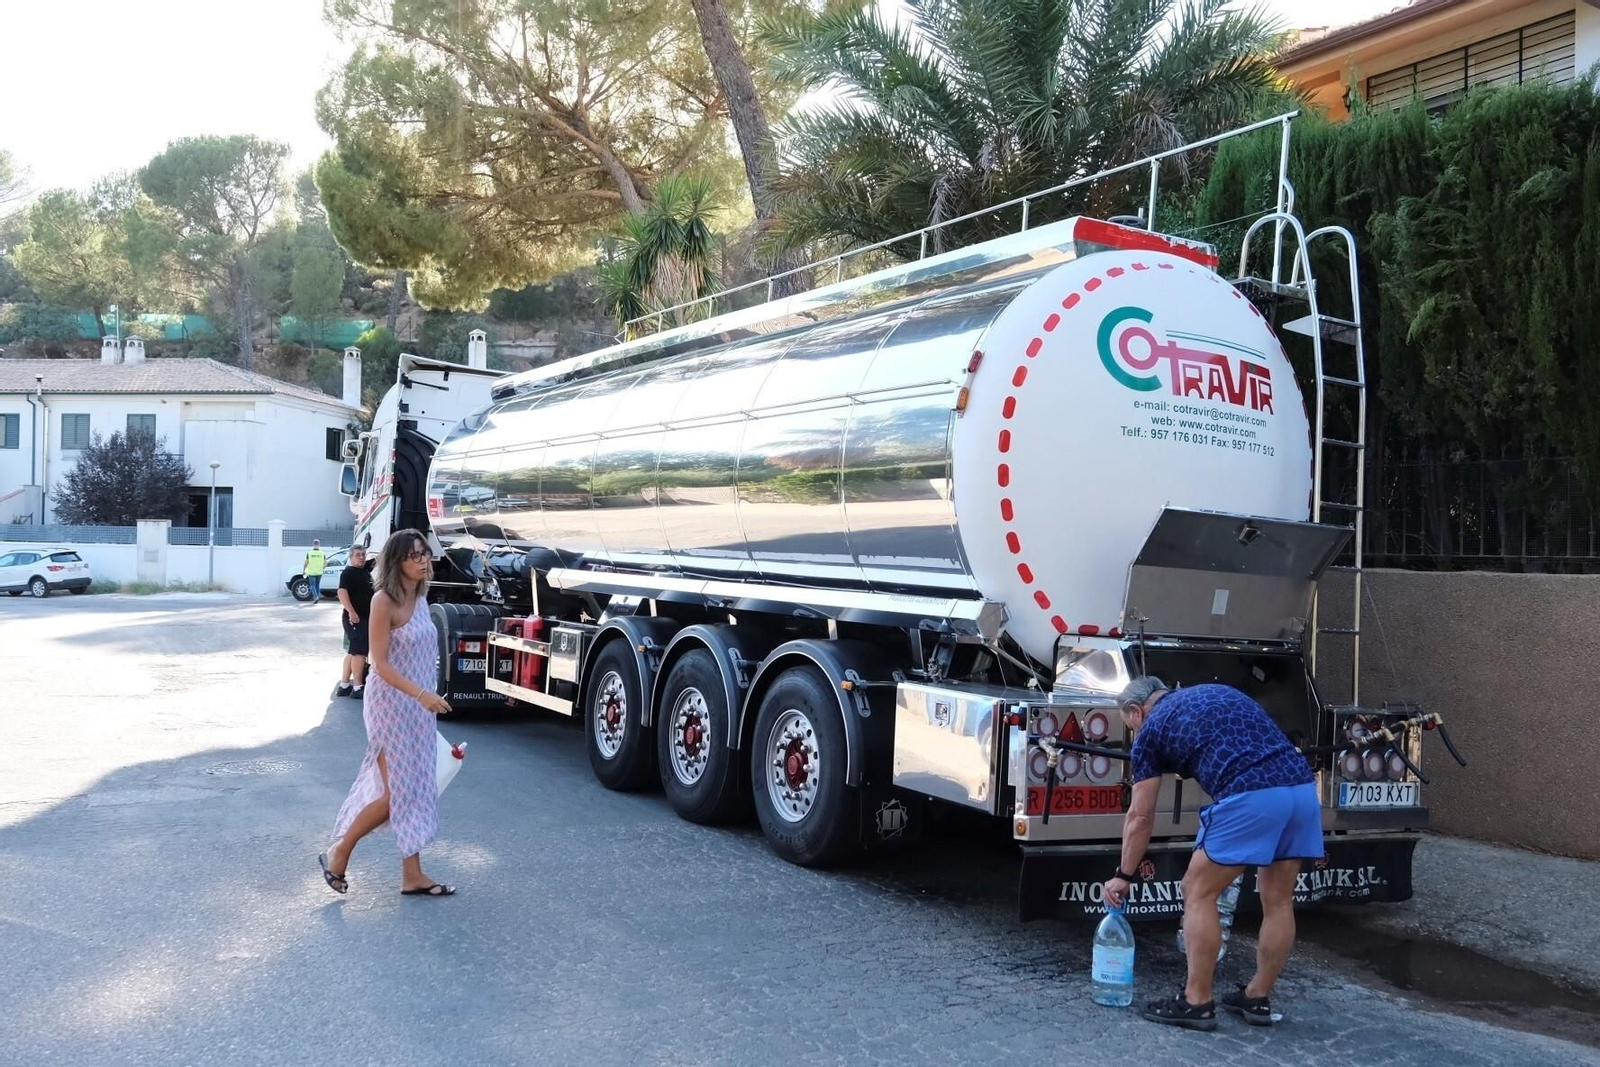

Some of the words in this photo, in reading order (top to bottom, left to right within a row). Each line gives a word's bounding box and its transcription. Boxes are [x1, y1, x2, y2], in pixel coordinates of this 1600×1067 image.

[1133, 400, 1170, 412] e-mail:
[1173, 404, 1267, 428] cotravir@cotravir.com
[1151, 415, 1176, 427] web:
[1179, 419, 1256, 439] www.cotravir.com
[1120, 425, 1147, 438] Telf.:
[1150, 428, 1169, 440] 957
[1172, 431, 1190, 443] 176
[1192, 433, 1208, 445] 031
[1211, 436, 1229, 448] Fax:
[1232, 439, 1247, 451] 957
[1249, 442, 1261, 454] 177
[1262, 445, 1275, 457] 512
[453, 692, 486, 700] RENAULT
[487, 692, 508, 700] TRUC
[1054, 790, 1084, 809] 256
[1088, 789, 1118, 809] BDD
[1349, 785, 1382, 803] 7103
[1386, 785, 1412, 803] KXT
